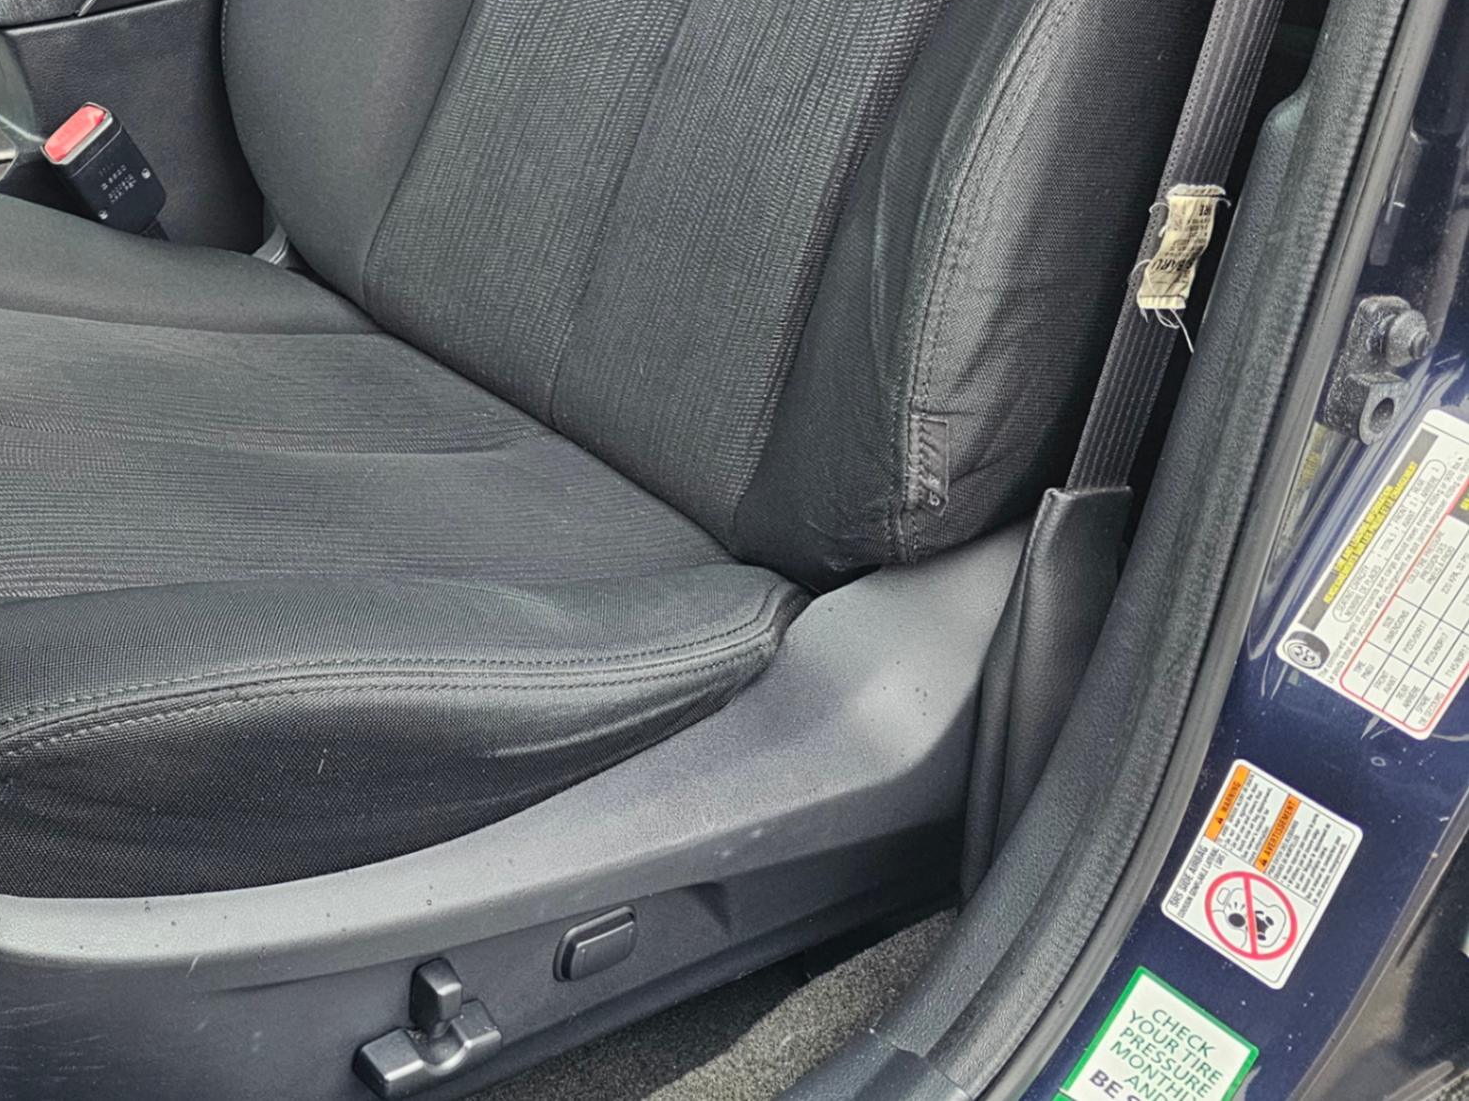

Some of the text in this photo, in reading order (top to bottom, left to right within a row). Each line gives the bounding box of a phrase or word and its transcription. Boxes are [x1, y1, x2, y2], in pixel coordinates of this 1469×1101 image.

[1220, 779, 1241, 813] WARNING
[1262, 799, 1296, 857] AVERTISSEMENT
[1119, 1026, 1213, 1098] PRESSURE
[1128, 1009, 1224, 1086] YOUR TIRE
[1151, 1008, 1216, 1058] CHECK
[1088, 1068, 1125, 1100] BE
[1109, 1041, 1197, 1101] MONTHL
